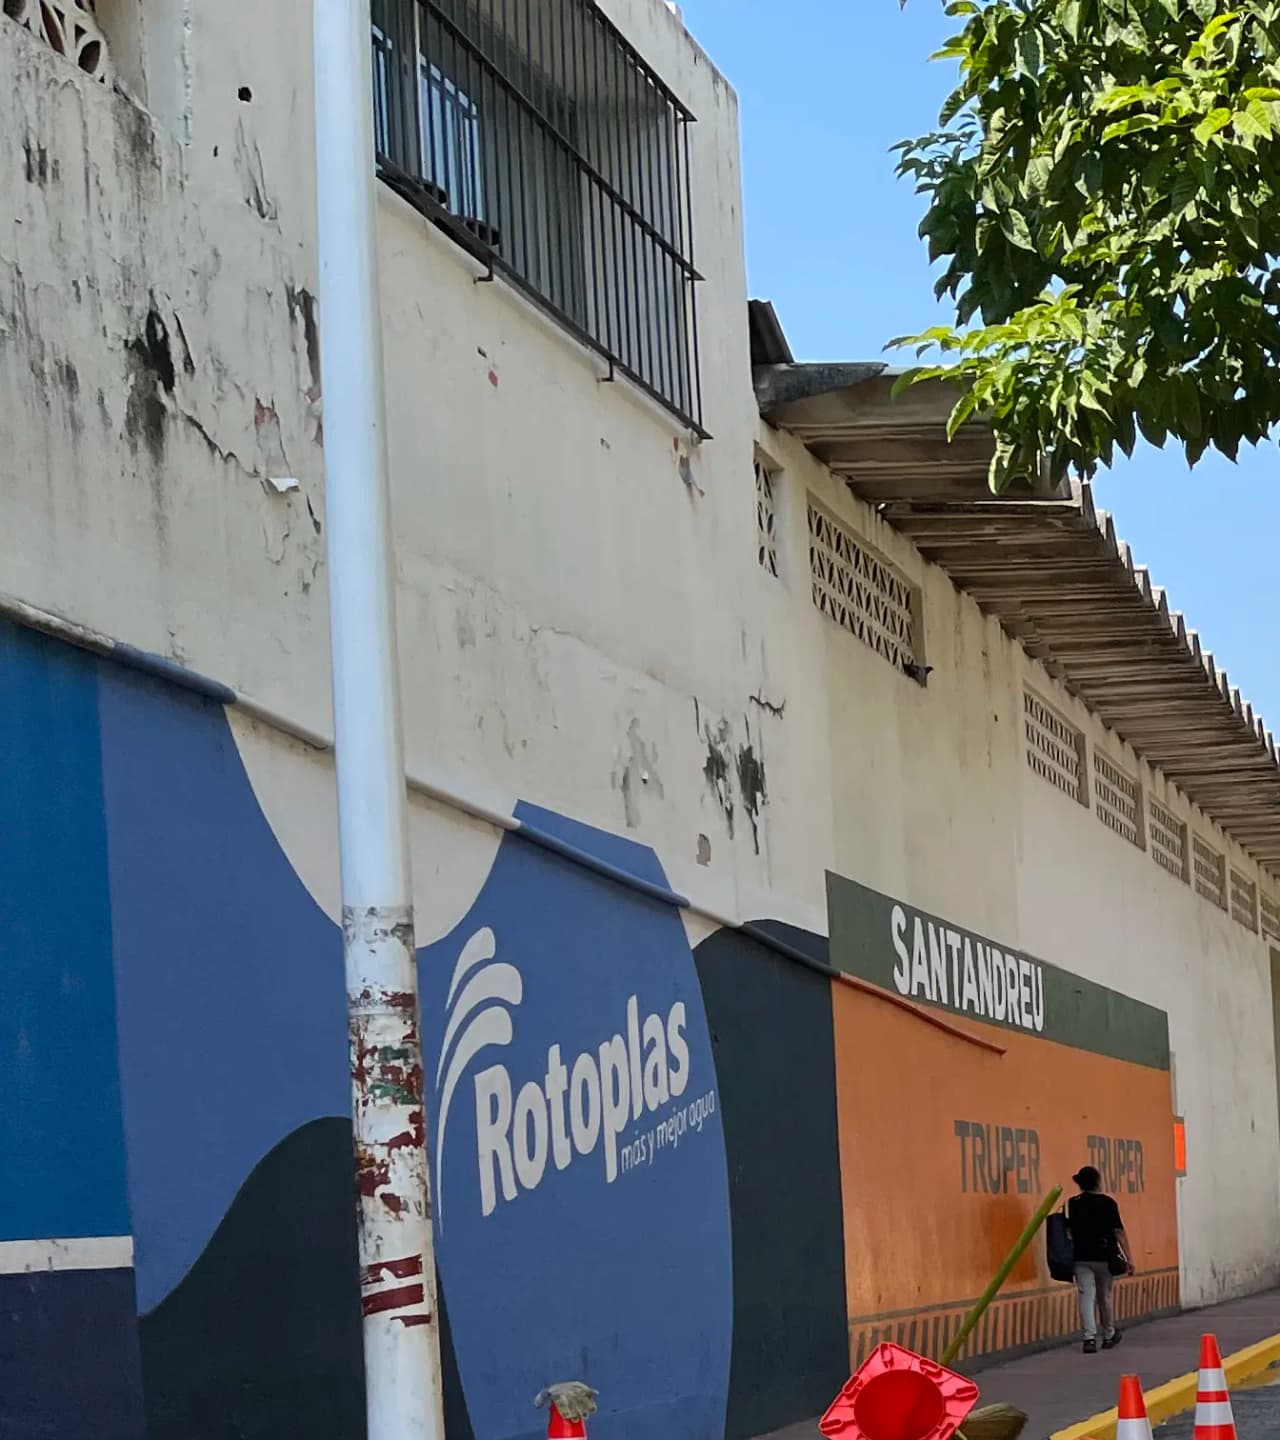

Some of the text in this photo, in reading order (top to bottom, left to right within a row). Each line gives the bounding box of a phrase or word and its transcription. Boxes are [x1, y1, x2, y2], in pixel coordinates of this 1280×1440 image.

[891, 904, 1044, 1032] SANTANDREU
[474, 994, 689, 1216] Rotoplas
[647, 1129, 655, 1166] y
[656, 1106, 687, 1149] mejor
[954, 1119, 1042, 1194] TRUPER
